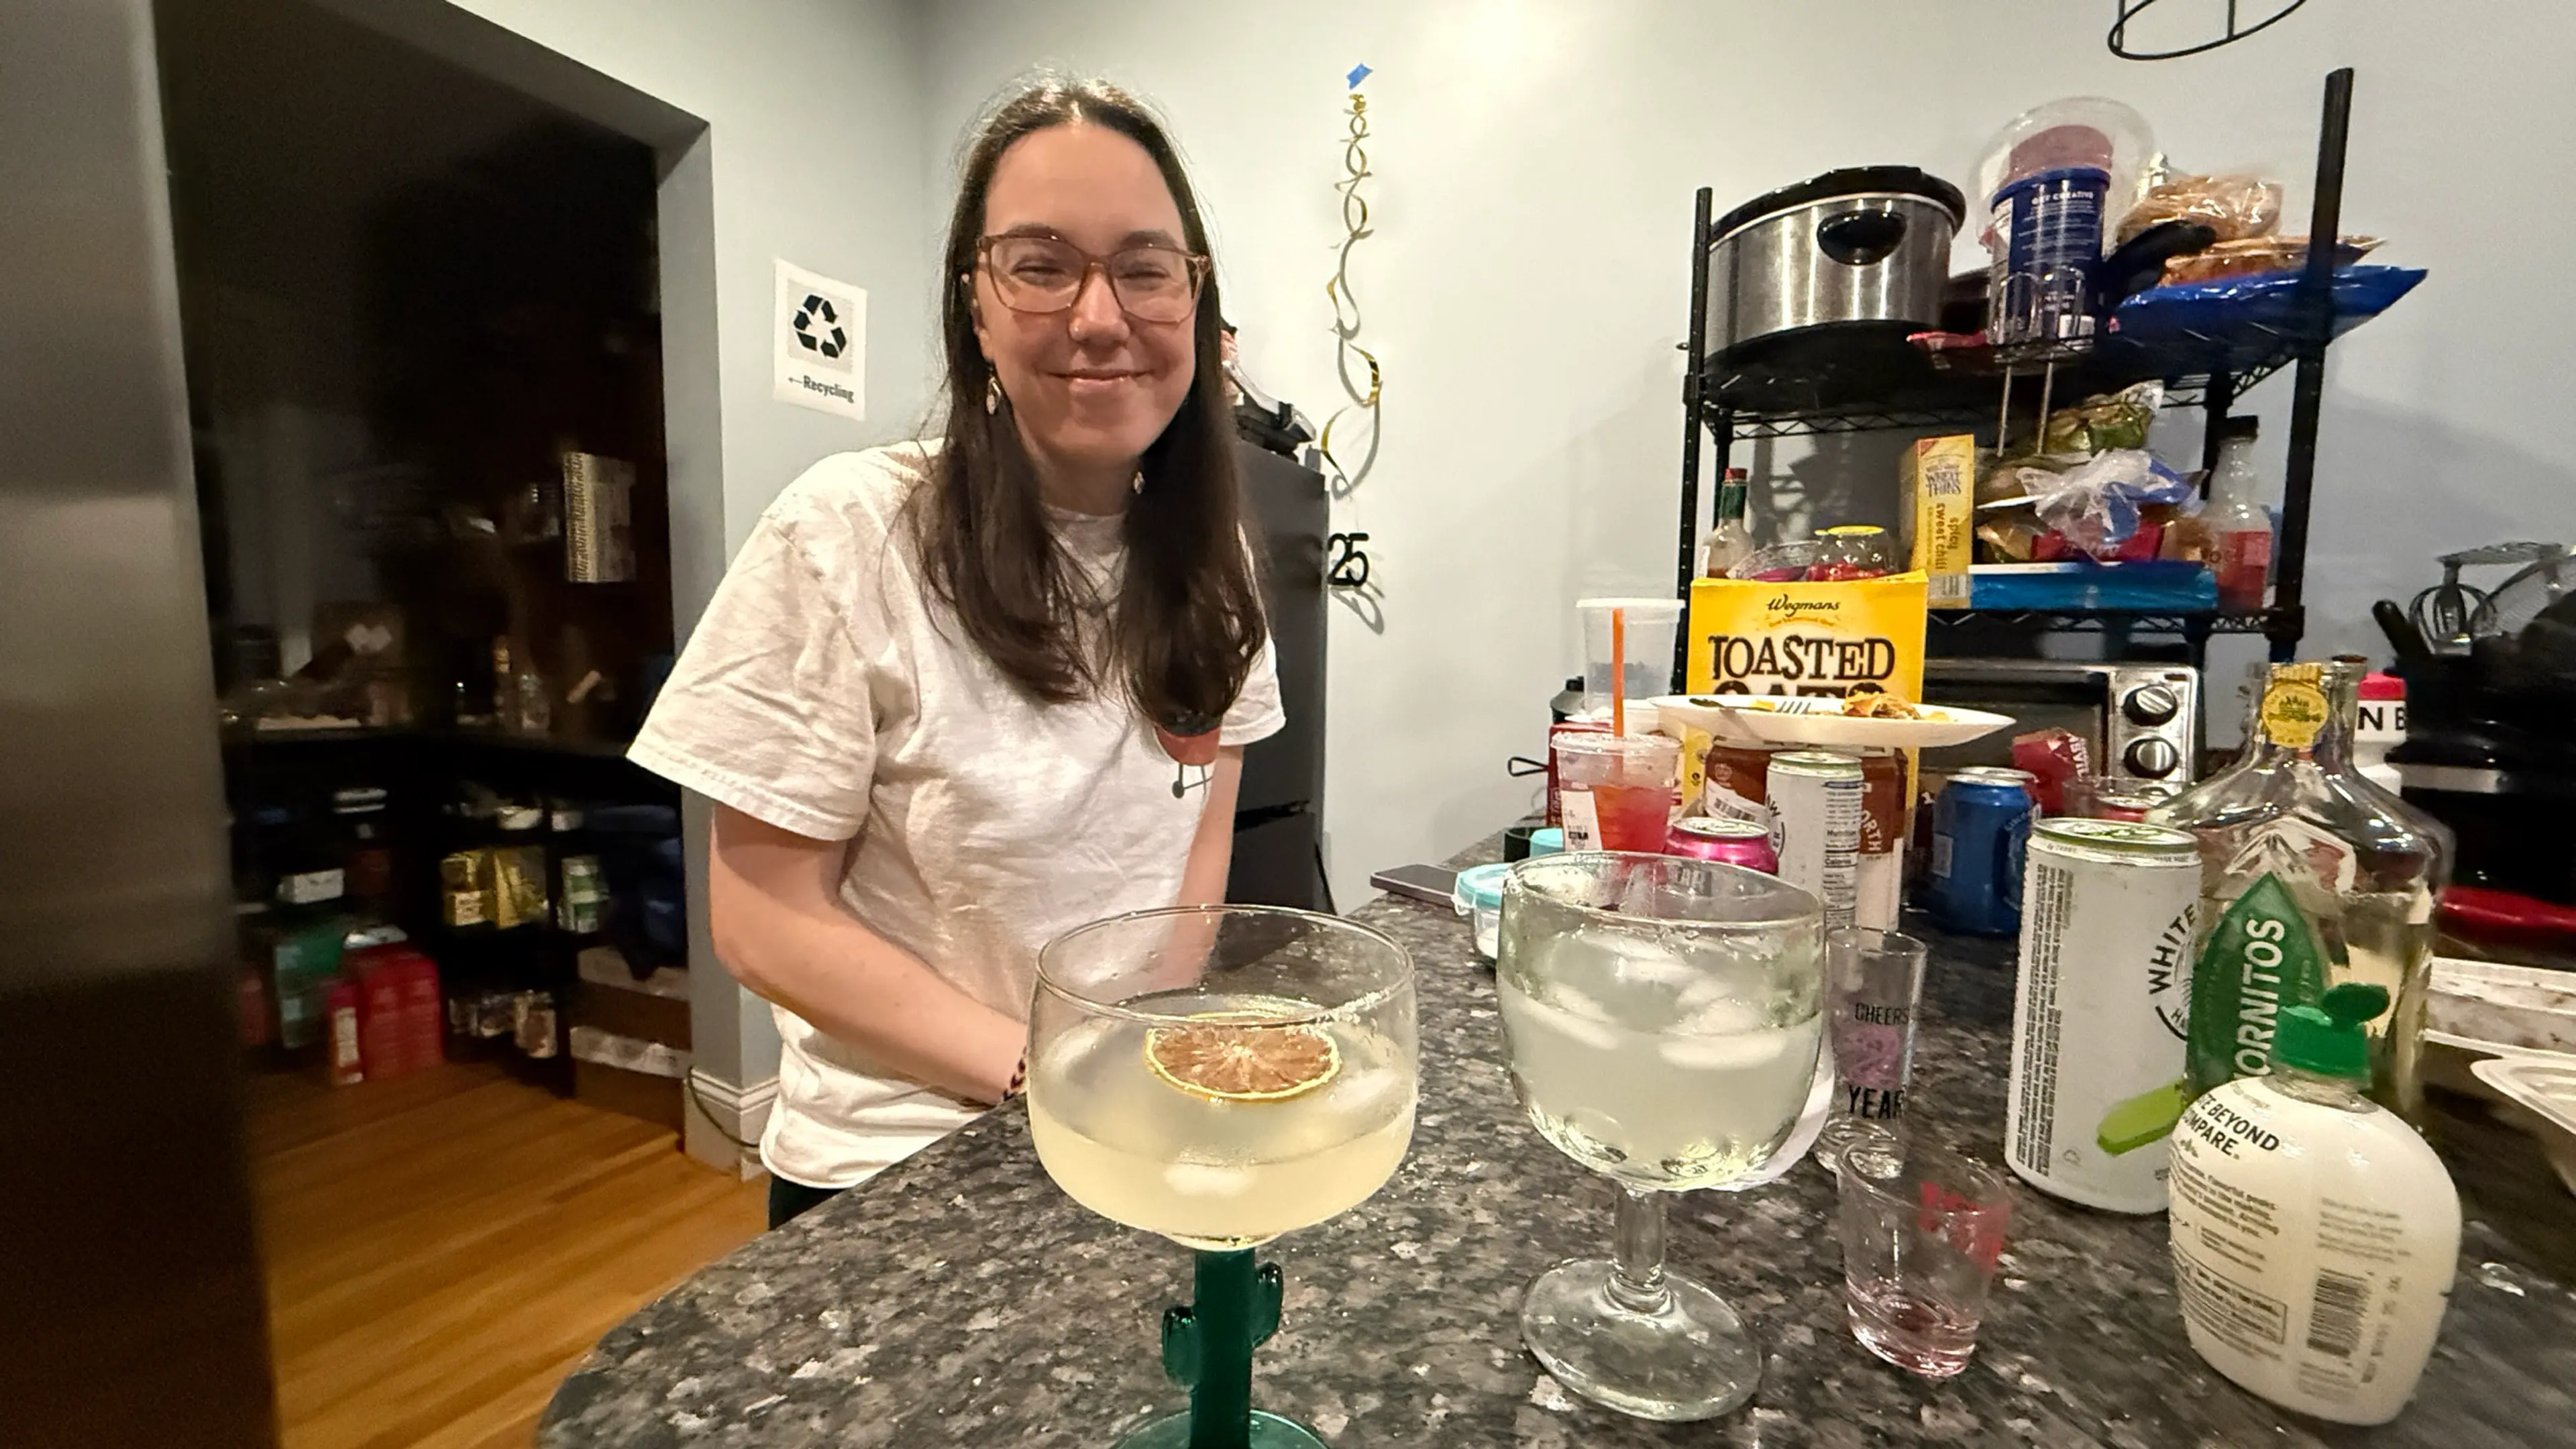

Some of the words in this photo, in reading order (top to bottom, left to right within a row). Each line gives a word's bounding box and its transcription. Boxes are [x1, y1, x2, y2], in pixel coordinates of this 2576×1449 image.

[803, 375, 855, 404] Recycling
[1935, 502, 1945, 541] sweet
[1947, 517, 1960, 550] spicy
[1328, 533, 1370, 587] 25
[1766, 594, 1841, 618] Wegmans
[1708, 635, 1896, 680] TOASTED
[2148, 903, 2196, 995] WHITE
[1855, 1002, 1911, 1024] CHEERS
[2207, 1103, 2280, 1151] BEYOND
